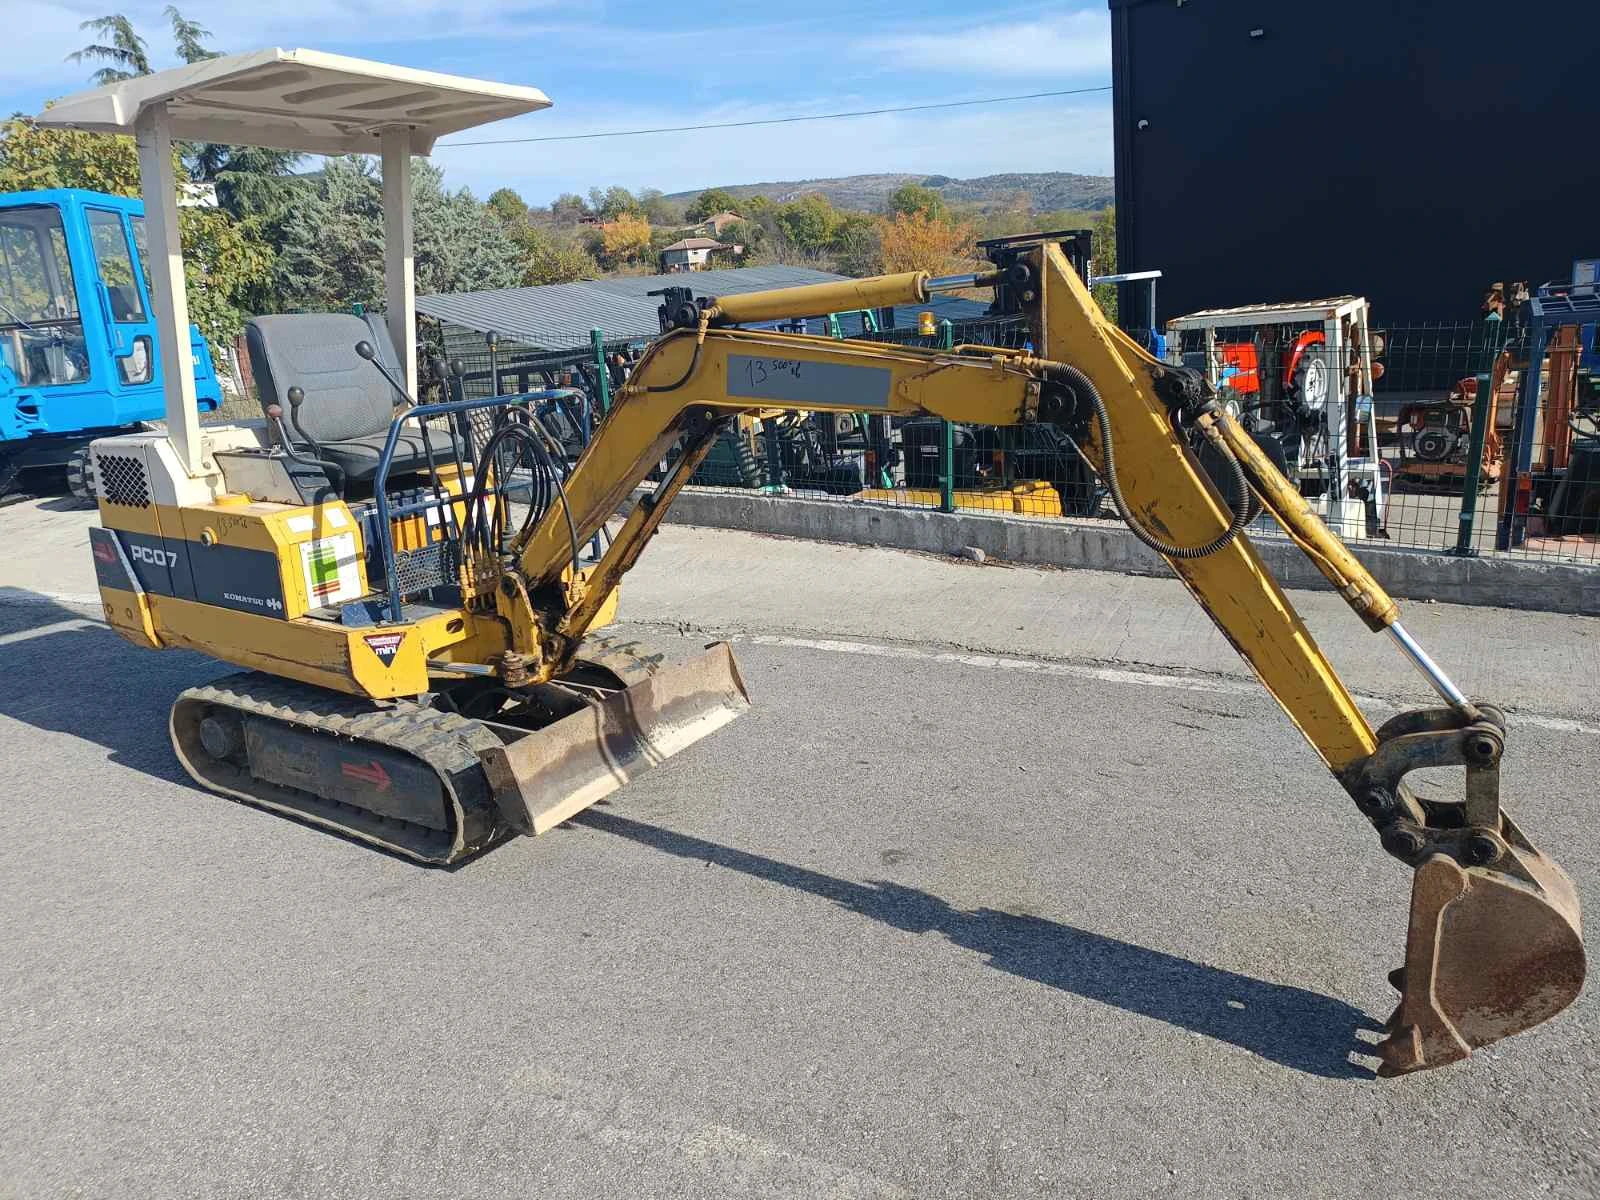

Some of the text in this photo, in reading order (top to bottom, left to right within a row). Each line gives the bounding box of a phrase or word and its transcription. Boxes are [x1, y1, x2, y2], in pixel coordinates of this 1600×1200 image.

[130, 544, 177, 568] PC07
[223, 593, 263, 606] KOMATSU
[376, 644, 397, 655] mini
